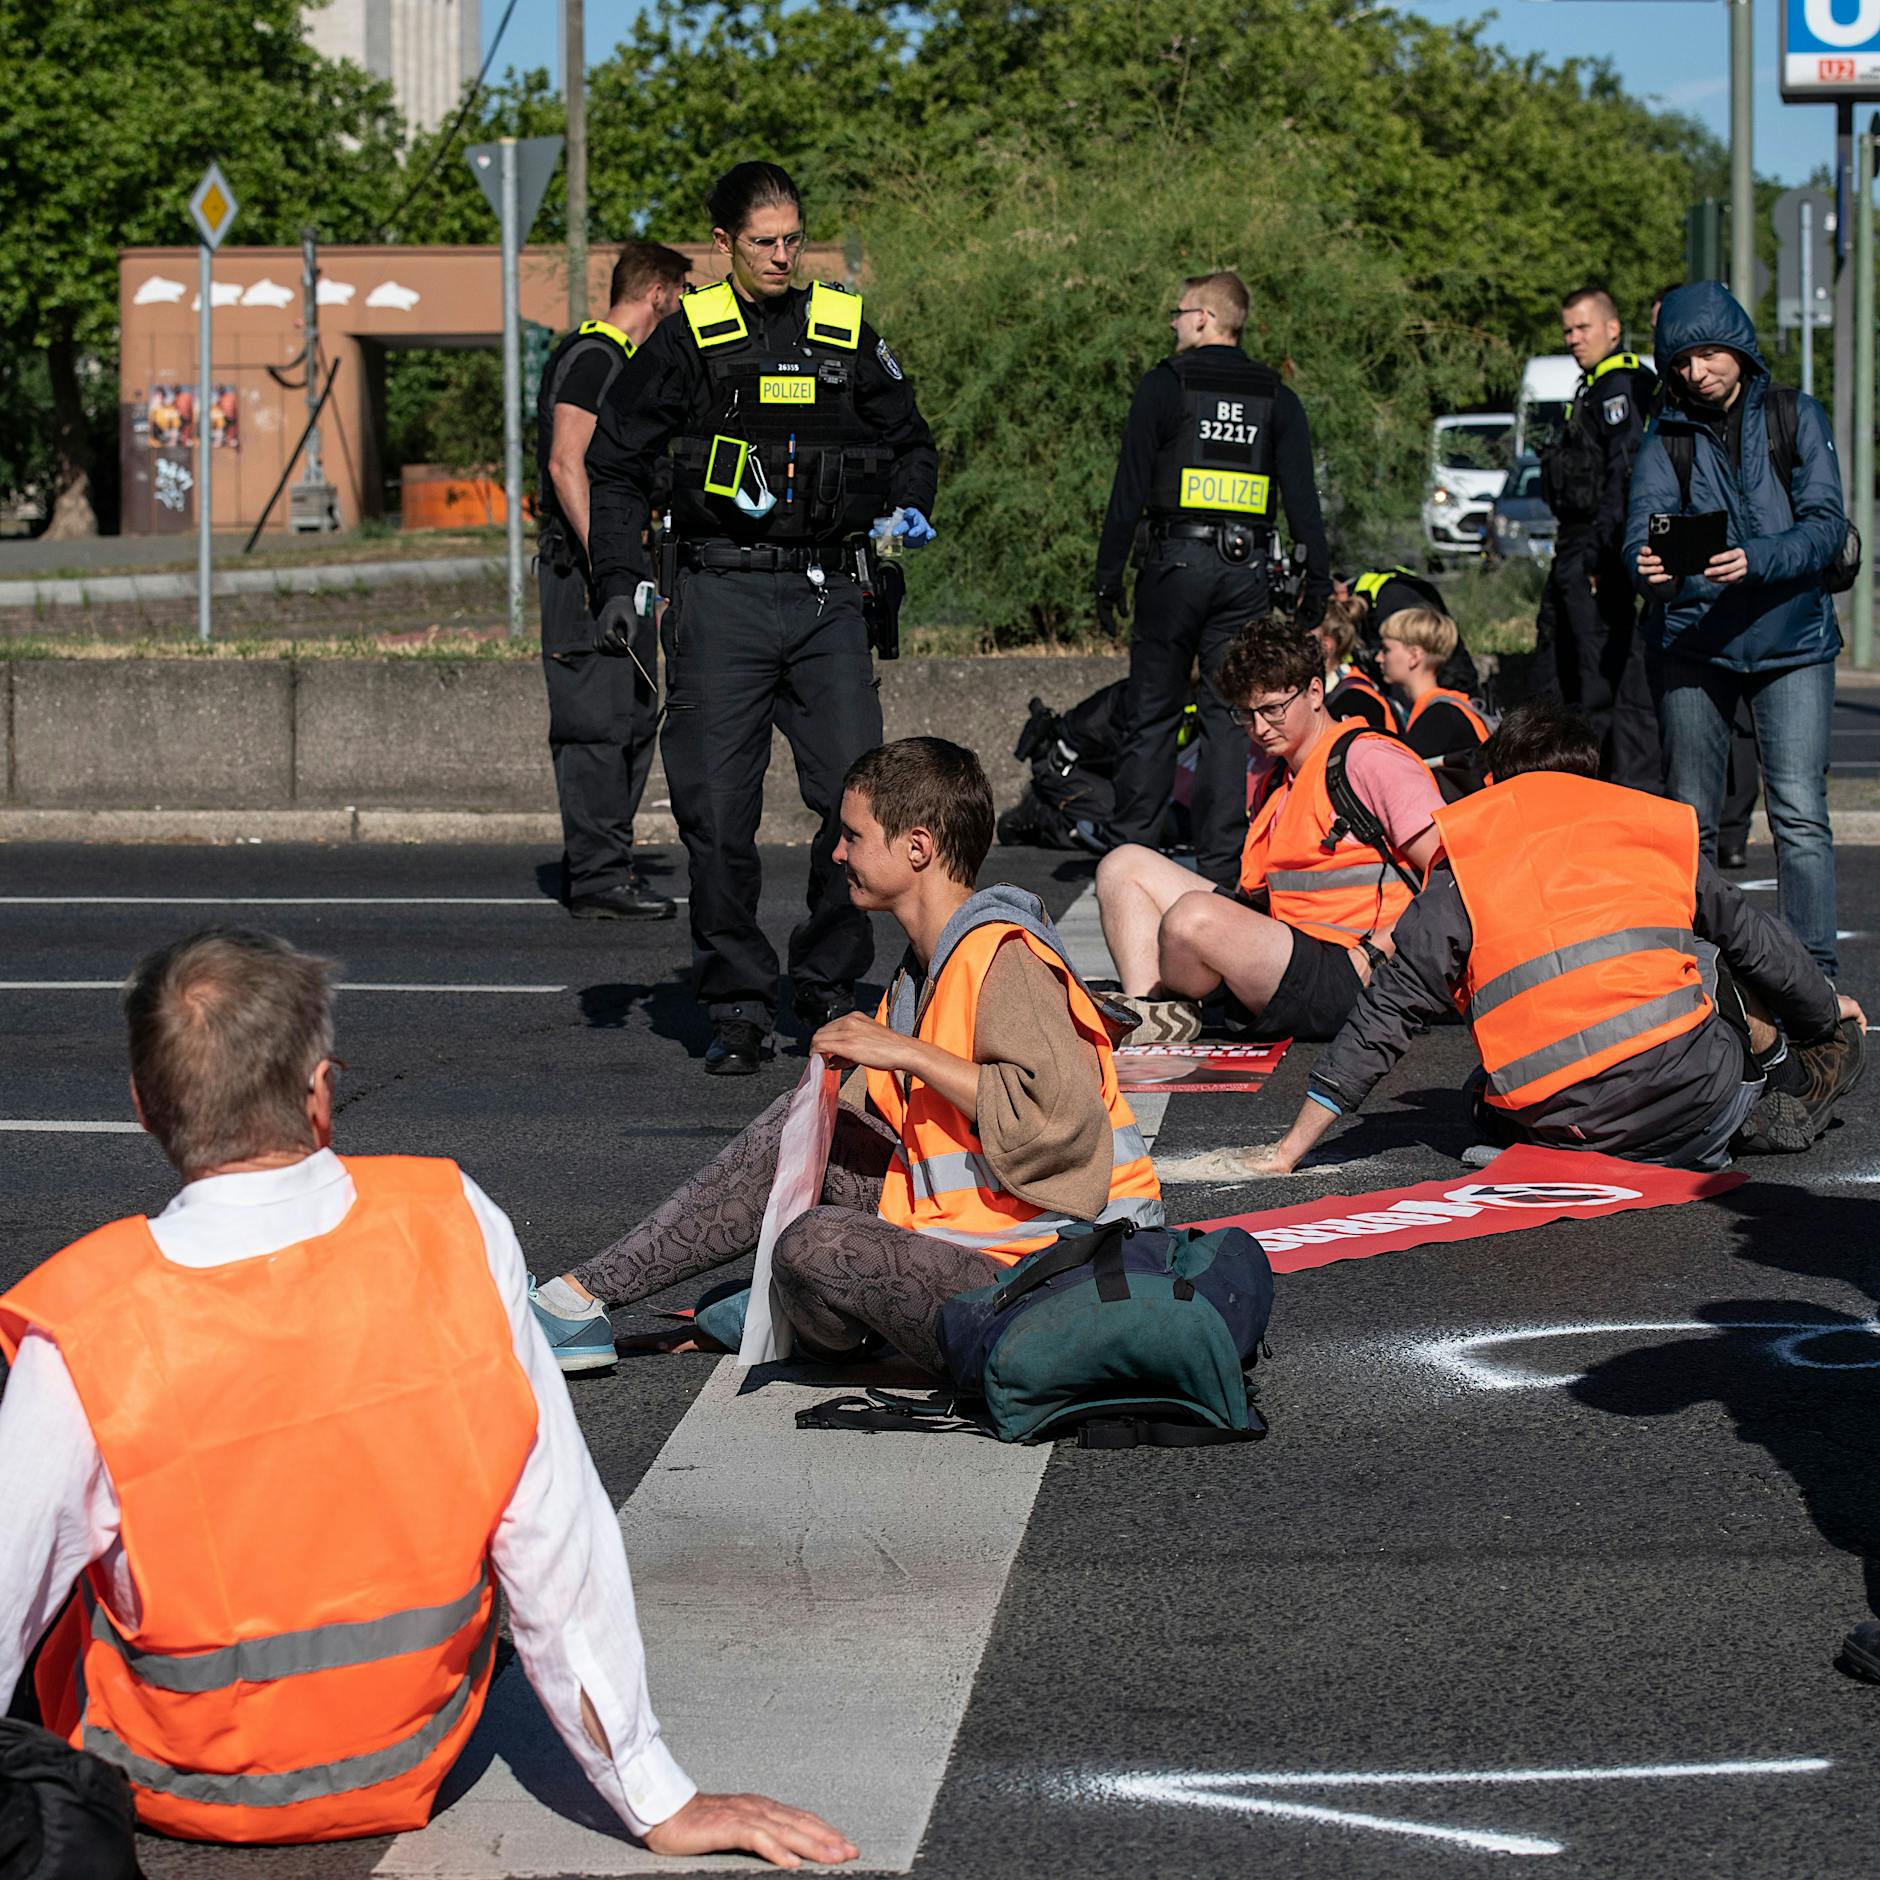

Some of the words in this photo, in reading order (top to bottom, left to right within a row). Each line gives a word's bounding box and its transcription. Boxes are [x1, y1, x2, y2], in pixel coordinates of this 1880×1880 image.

[1820, 60, 1855, 80] U2
[763, 382, 811, 398] POLIZEI
[1217, 401, 1244, 422] BE
[1199, 420, 1258, 444] 32217
[1187, 475, 1265, 507] POLIZEI
